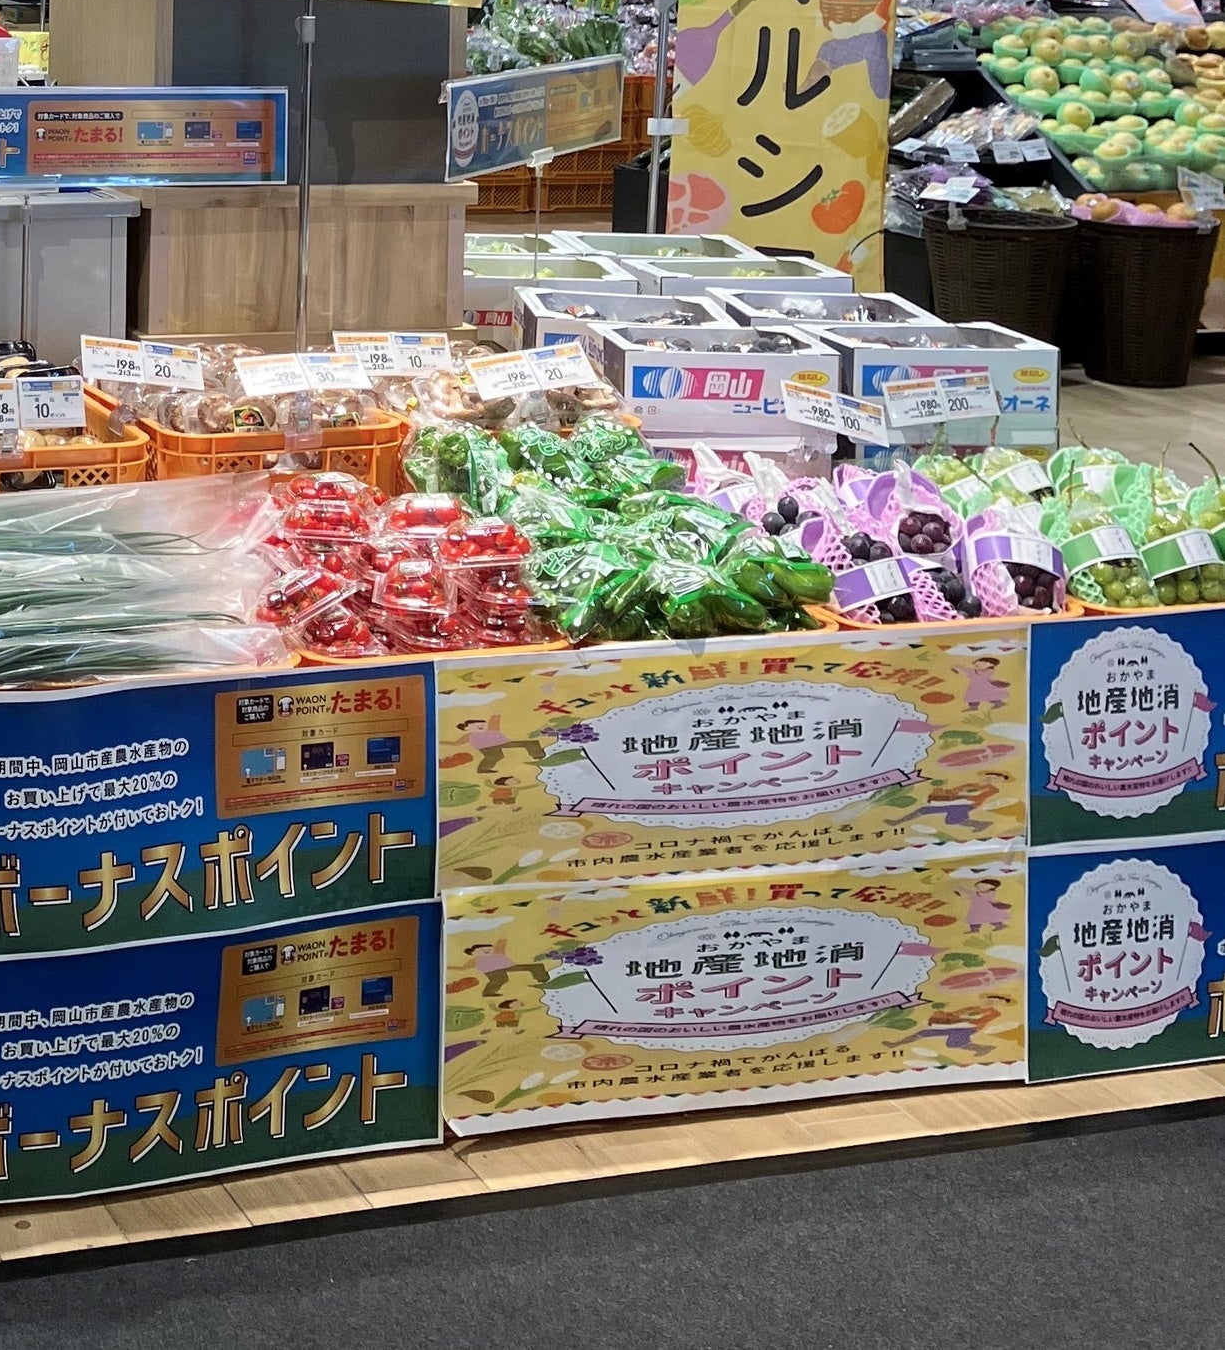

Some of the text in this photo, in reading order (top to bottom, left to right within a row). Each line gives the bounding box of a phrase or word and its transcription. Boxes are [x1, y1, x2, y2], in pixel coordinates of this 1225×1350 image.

[484, 311, 509, 326] 岡山
[154, 364, 171, 378] 20
[407, 355, 422, 368] 10
[544, 367, 563, 381] 20
[316, 371, 335, 382] 30
[702, 370, 754, 398] 岡山
[34, 402, 50, 418] 10
[947, 397, 970, 412] 200
[841, 414, 861, 432] 100
[1106, 669, 1156, 684] おかやま
[296, 695, 326, 706] WAON
[331, 687, 402, 714] たまる!
[1077, 684, 1179, 716] 地産地消
[691, 710, 805, 728] おかやま
[622, 718, 863, 756] 地産地消
[1081, 716, 1180, 750] ポイント
[632, 744, 863, 781] ポイント
[1088, 749, 1169, 772] キャンペーン
[5, 772, 177, 808] お買い上げで最大20%の
[651, 769, 838, 795] キャンペーン
[566, 827, 905, 868] 市内農水産業者を応援します!!
[634, 824, 854, 851] コロナ禍でがんばる
[1102, 900, 1152, 915] おかやま
[328, 930, 397, 958] たまる!
[696, 935, 810, 953] おかやま
[1073, 914, 1175, 948] 地産地消
[296, 941, 326, 952] WAON
[625, 941, 864, 980] 地産地消
[1077, 947, 1174, 982] ポイント
[635, 967, 863, 1004] ポイント
[1084, 979, 1163, 1004] キャンペーン
[653, 992, 837, 1019] キャンペーン
[2, 1024, 180, 1060] お買い上げで最大20%の
[566, 1049, 905, 1090] 市内農水産業者を応援します!!
[633, 1044, 851, 1073] コロナ禍でがんばる
